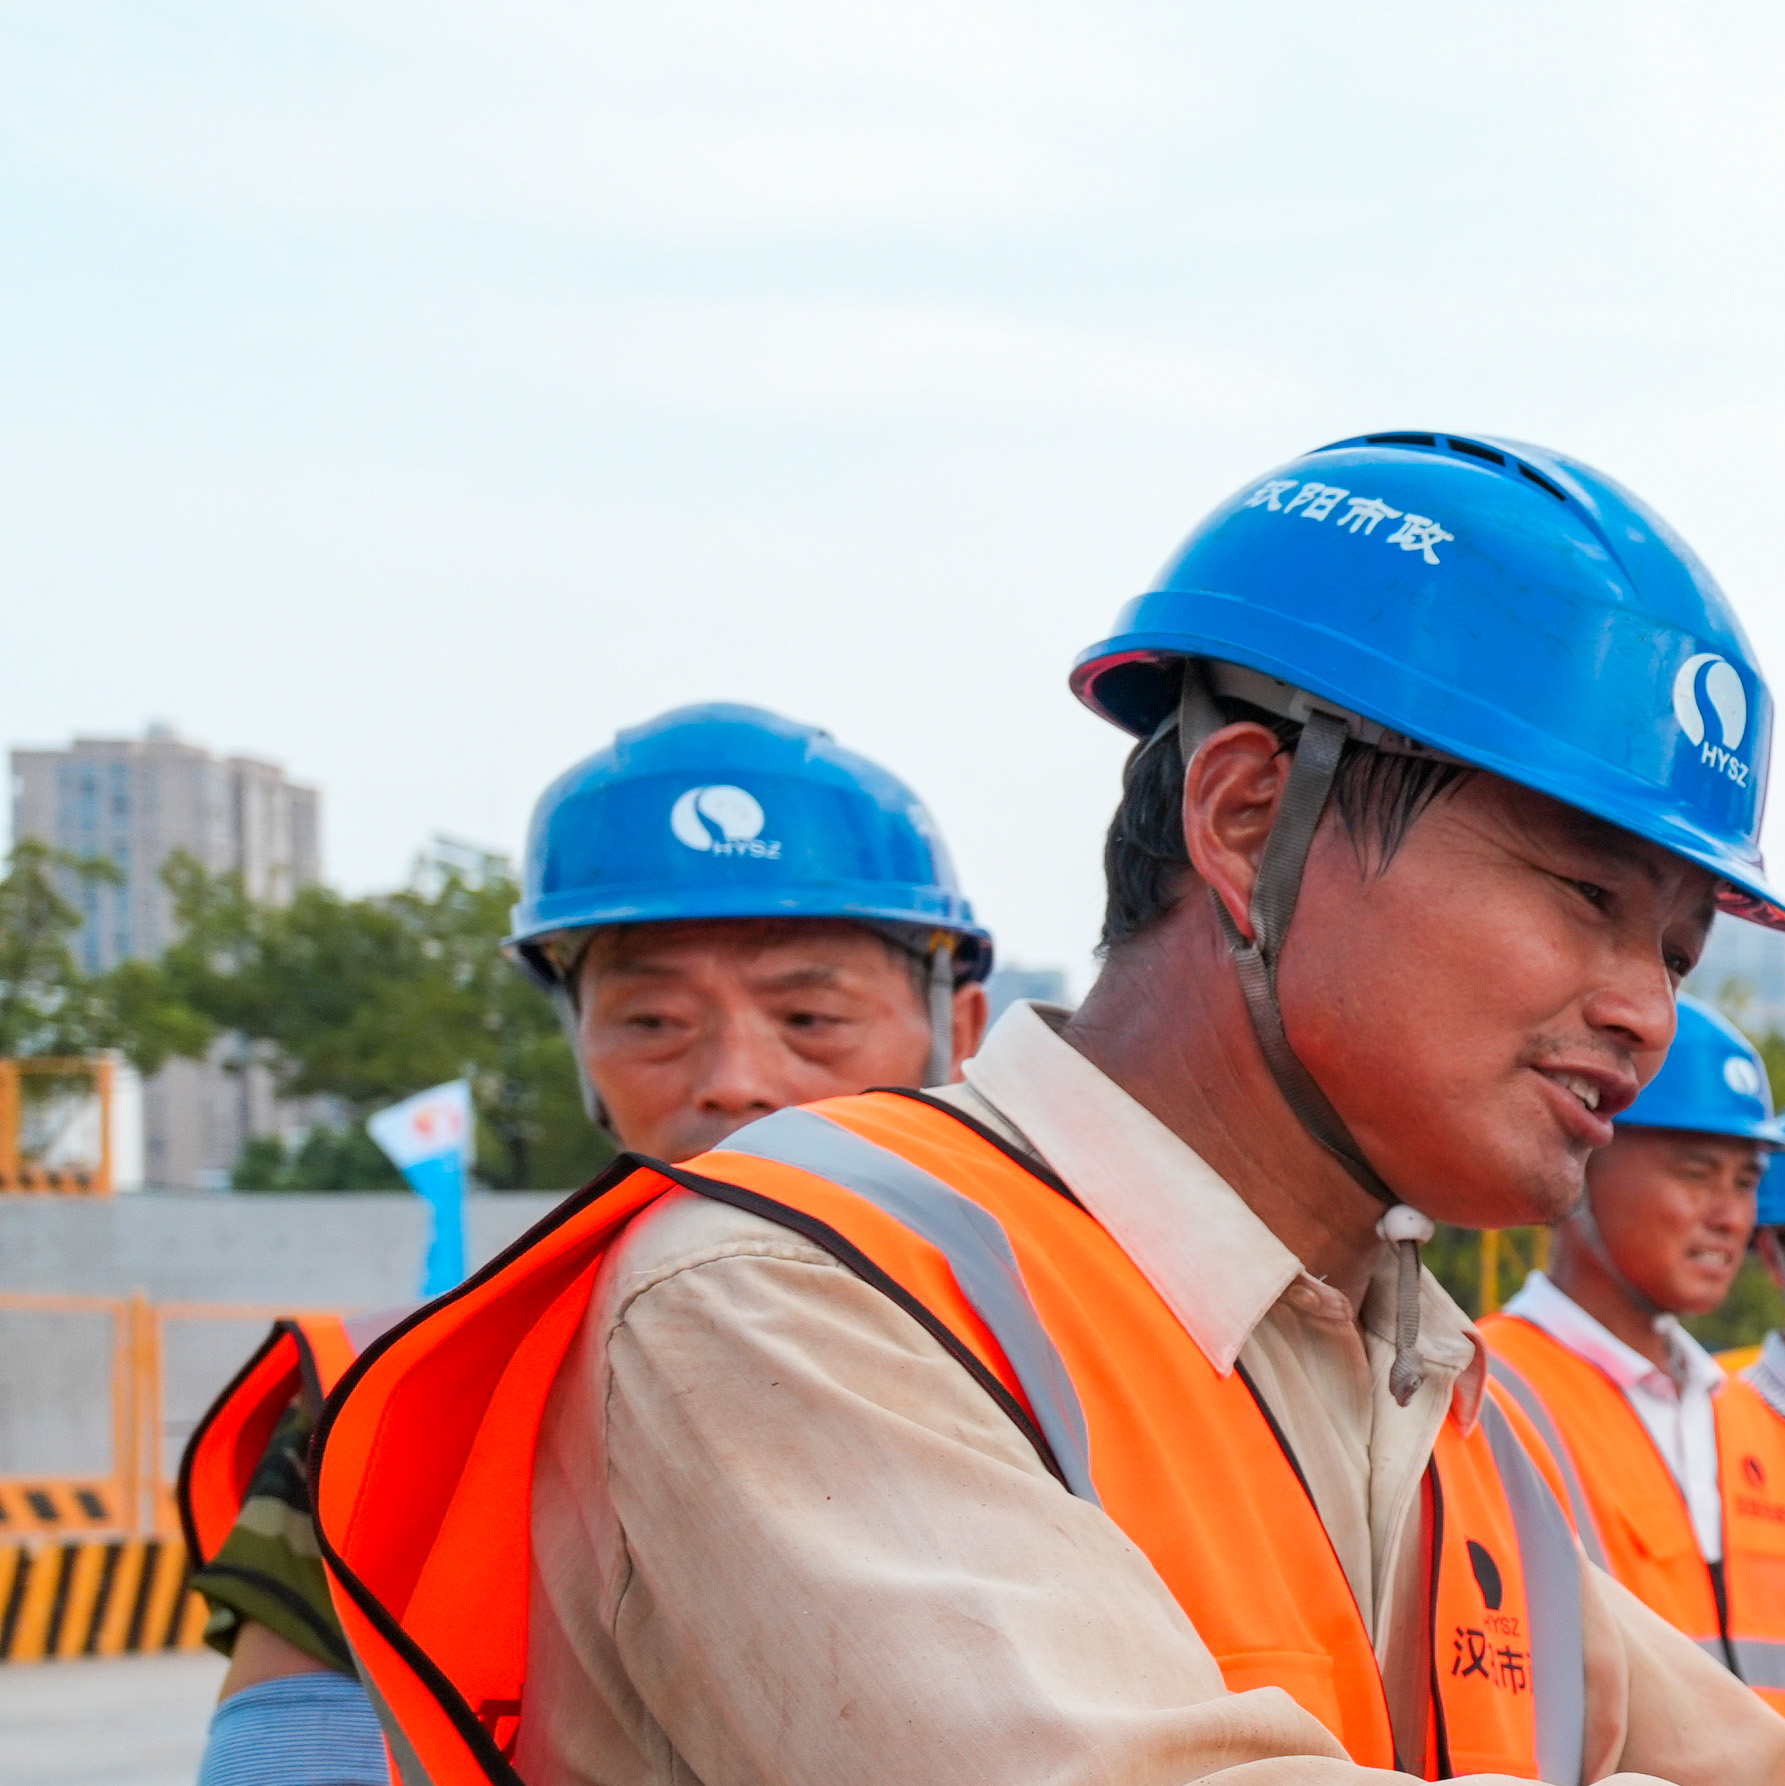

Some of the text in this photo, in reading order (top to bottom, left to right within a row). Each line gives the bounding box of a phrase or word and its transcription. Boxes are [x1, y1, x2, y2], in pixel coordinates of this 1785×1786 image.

[1245, 480, 1455, 565] 汉阳市政
[1701, 741, 1749, 788] HYSZ
[712, 840, 782, 859] HYSZ
